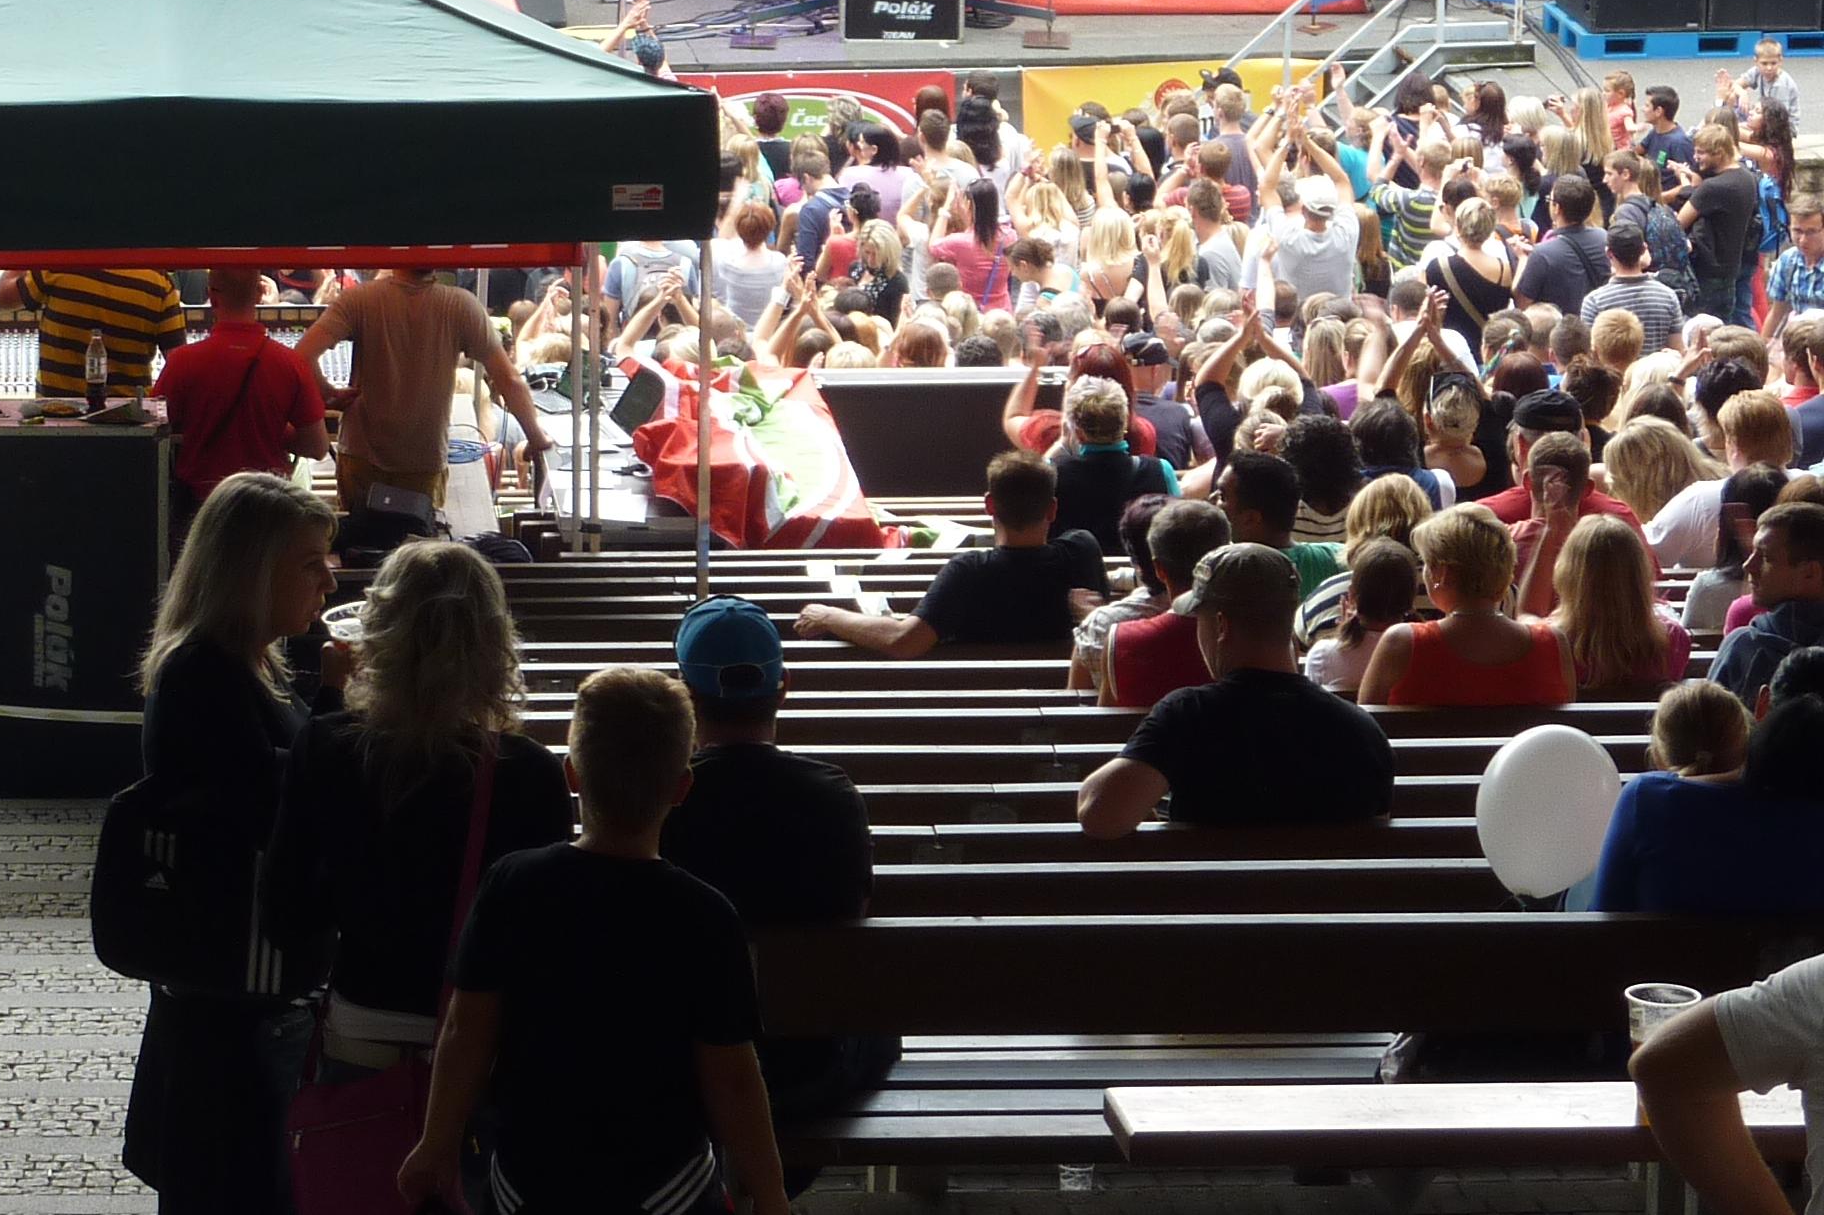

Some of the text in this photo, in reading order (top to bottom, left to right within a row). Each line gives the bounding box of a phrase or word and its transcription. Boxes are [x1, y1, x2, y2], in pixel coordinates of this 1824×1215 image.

[873, 0, 936, 15] Polák
[789, 108, 829, 128] Čec
[45, 564, 75, 692] Polák
